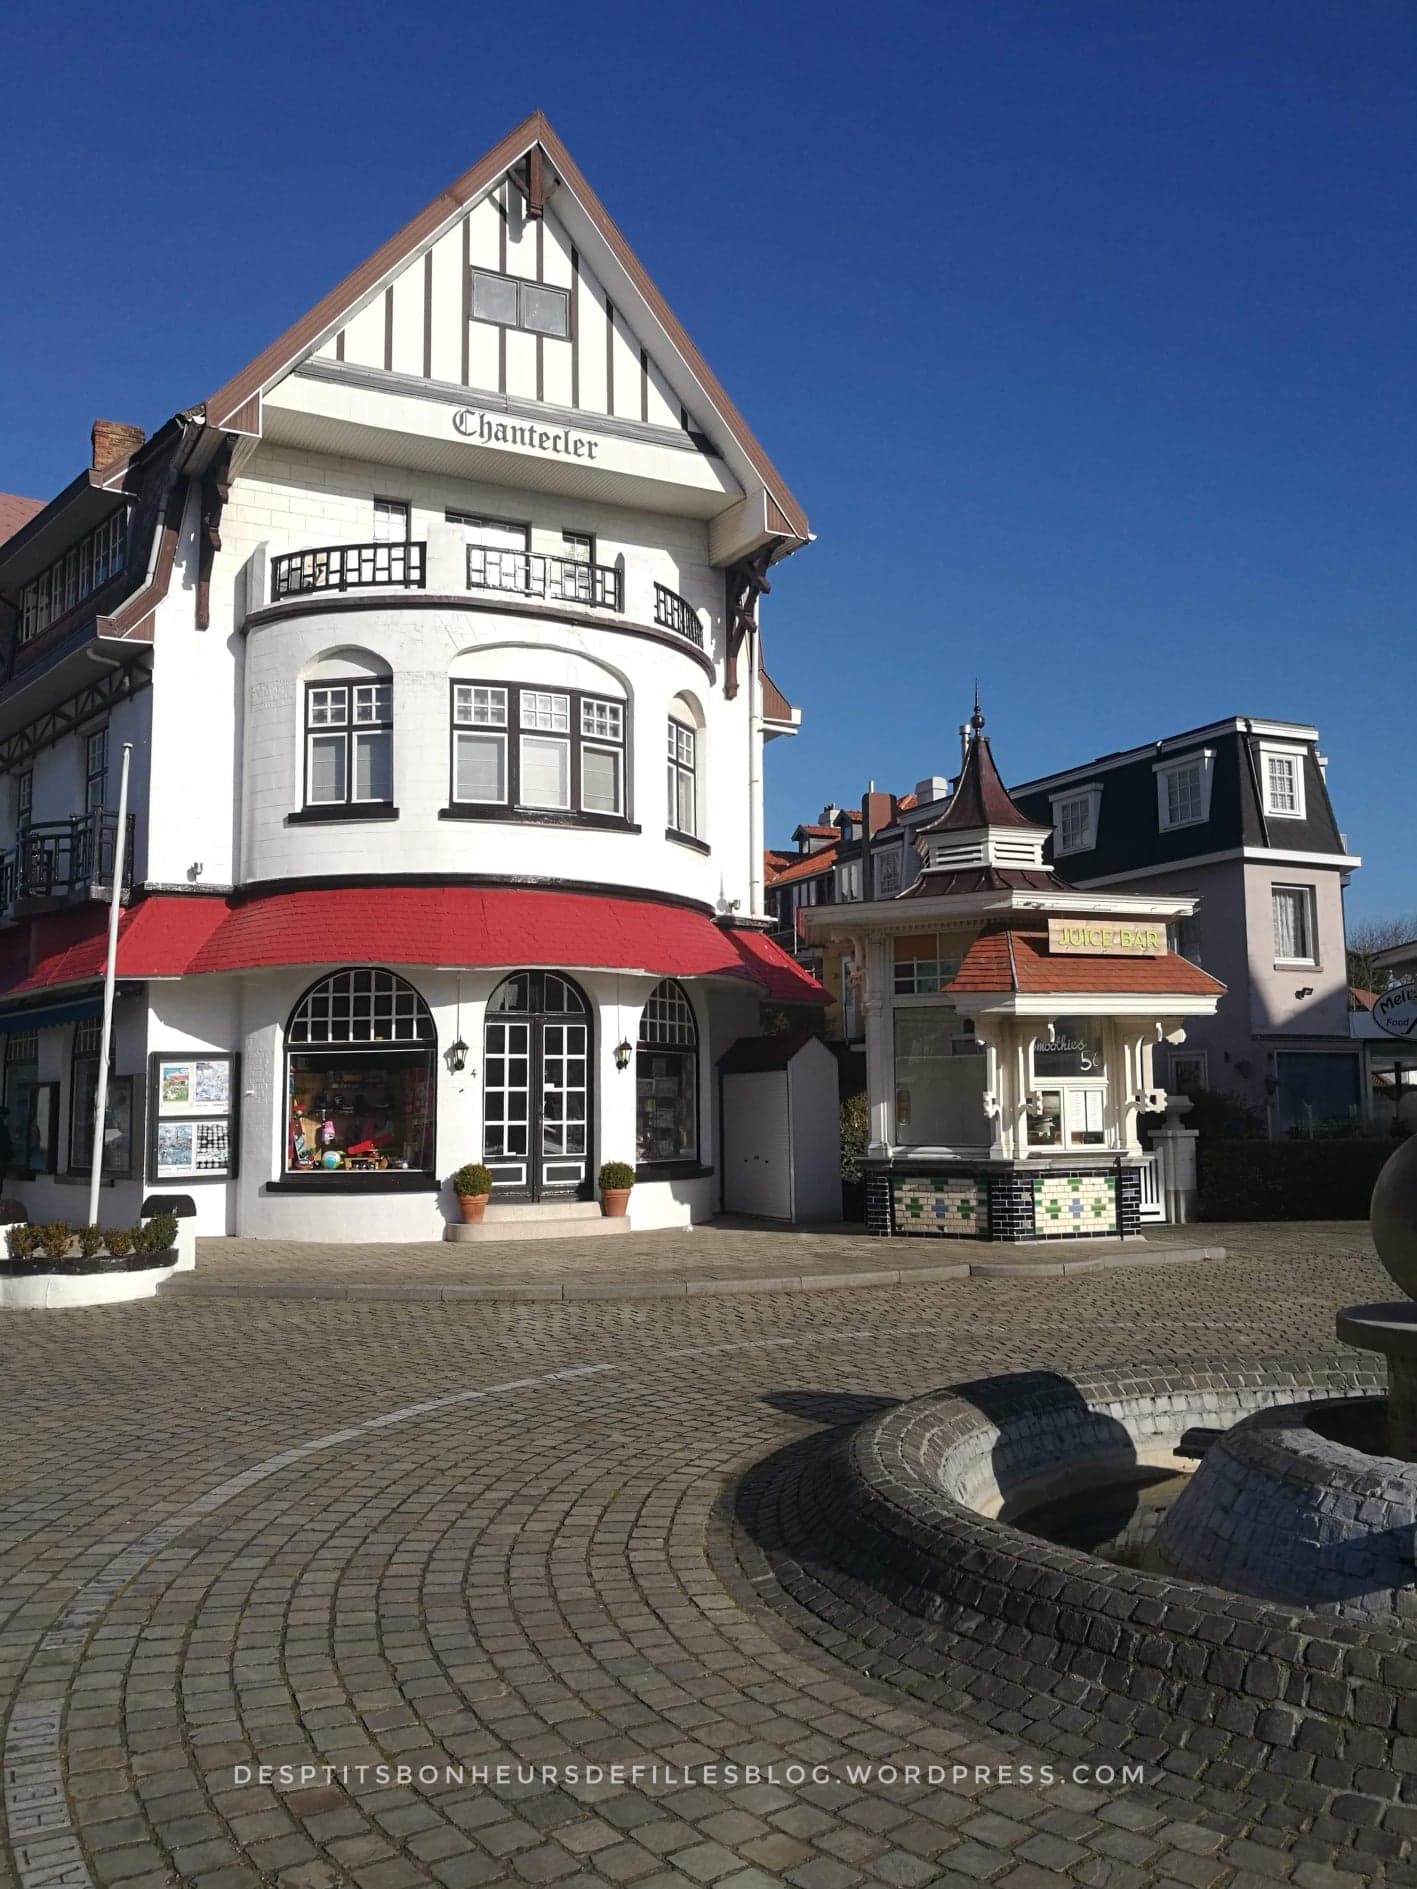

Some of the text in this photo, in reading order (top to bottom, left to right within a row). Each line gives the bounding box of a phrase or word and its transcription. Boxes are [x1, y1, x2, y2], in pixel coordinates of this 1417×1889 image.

[452, 408, 599, 460] Chantecler
[1058, 928, 1160, 948] JUICE BAR
[1386, 1017, 1410, 1027] Food
[1034, 1034, 1088, 1052] moothies
